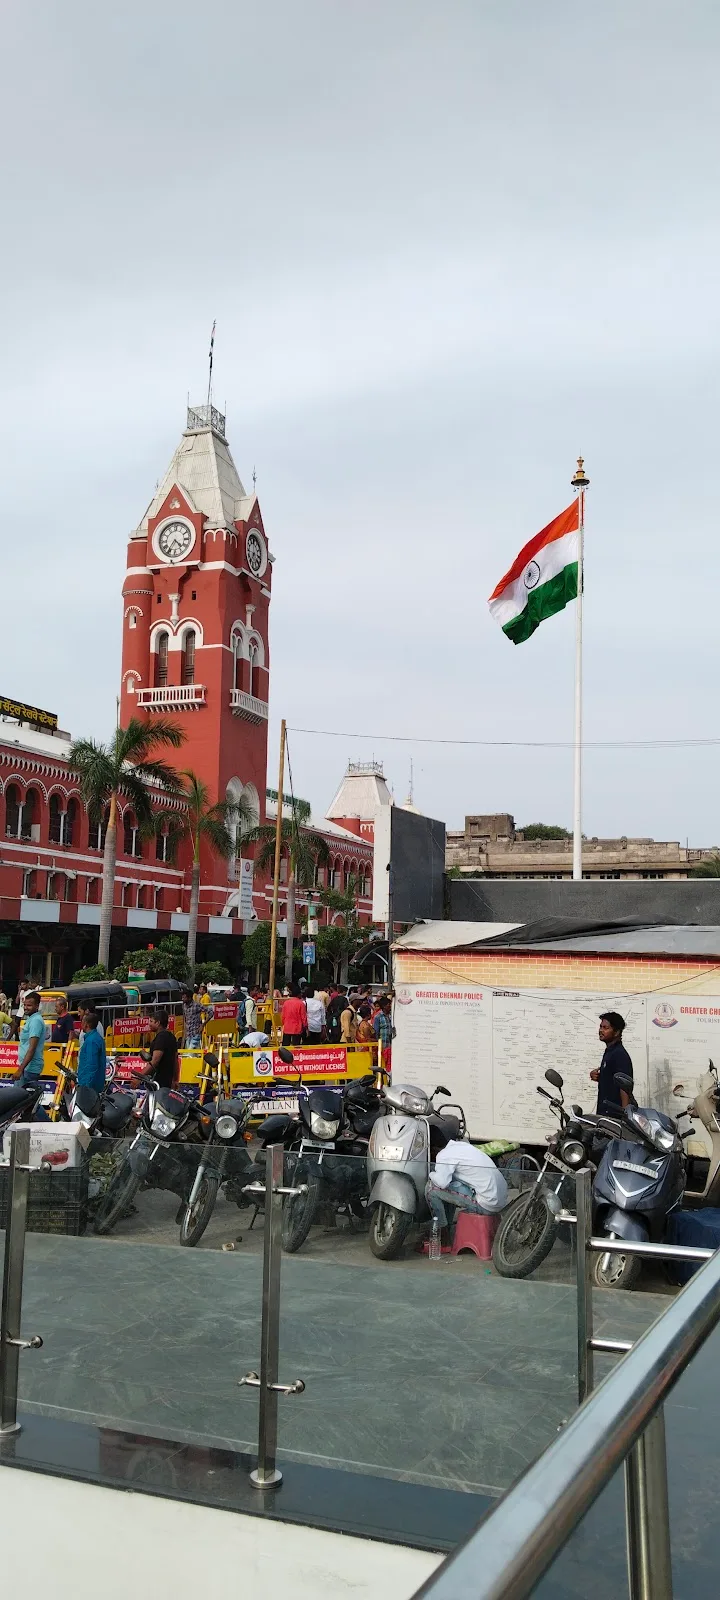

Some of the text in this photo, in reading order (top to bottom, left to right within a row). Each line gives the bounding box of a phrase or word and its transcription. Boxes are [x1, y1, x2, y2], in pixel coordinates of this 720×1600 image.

[415, 990, 483, 1000] GREATER CHENNAI POLICE
[680, 1006, 708, 1015] GREATER
[115, 1018, 138, 1026] Chennai
[120, 1026, 135, 1034] Obey
